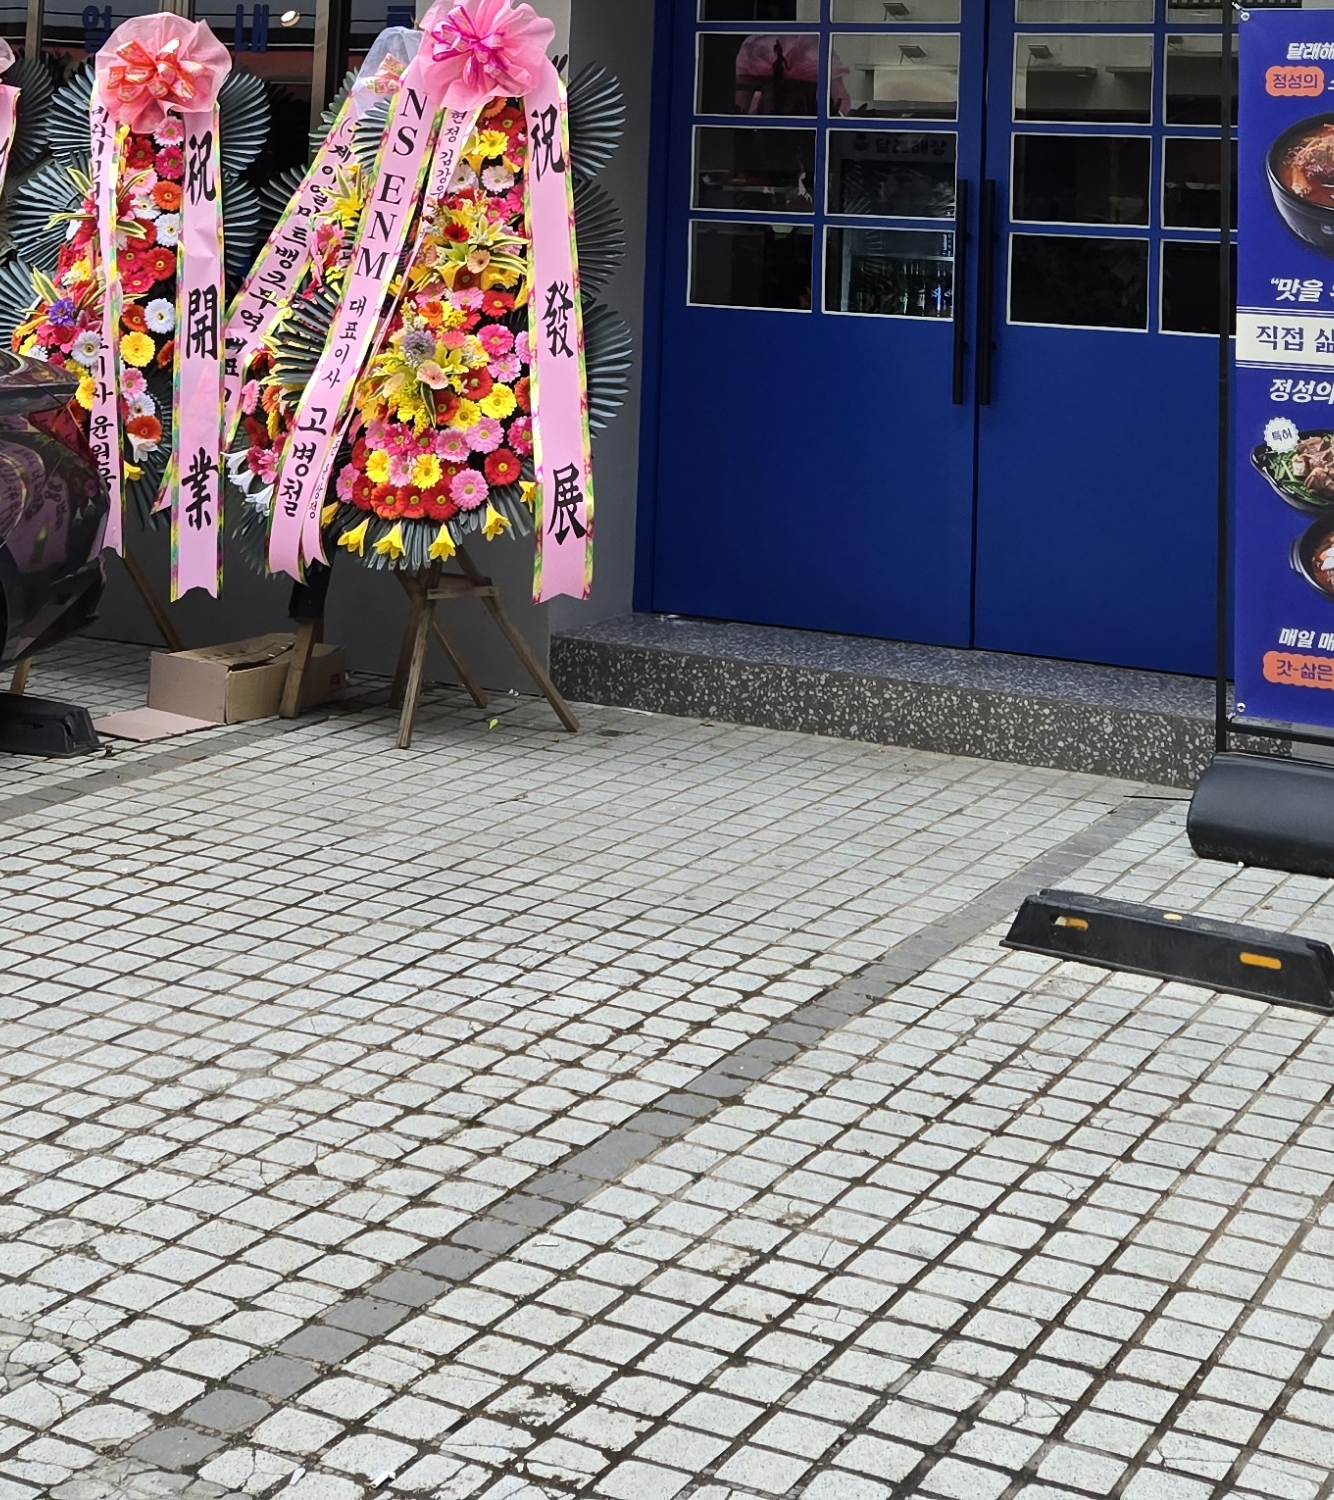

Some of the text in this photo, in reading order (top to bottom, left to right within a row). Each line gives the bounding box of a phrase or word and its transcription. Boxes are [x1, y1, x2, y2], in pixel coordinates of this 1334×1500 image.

[1272, 73, 1318, 90] 정성의
[354, 172, 405, 281] ENM
[322, 296, 367, 390] 대표이사
[1255, 325, 1305, 352] 직접
[279, 406, 328, 518] 고병철
[1279, 627, 1315, 648] 매일
